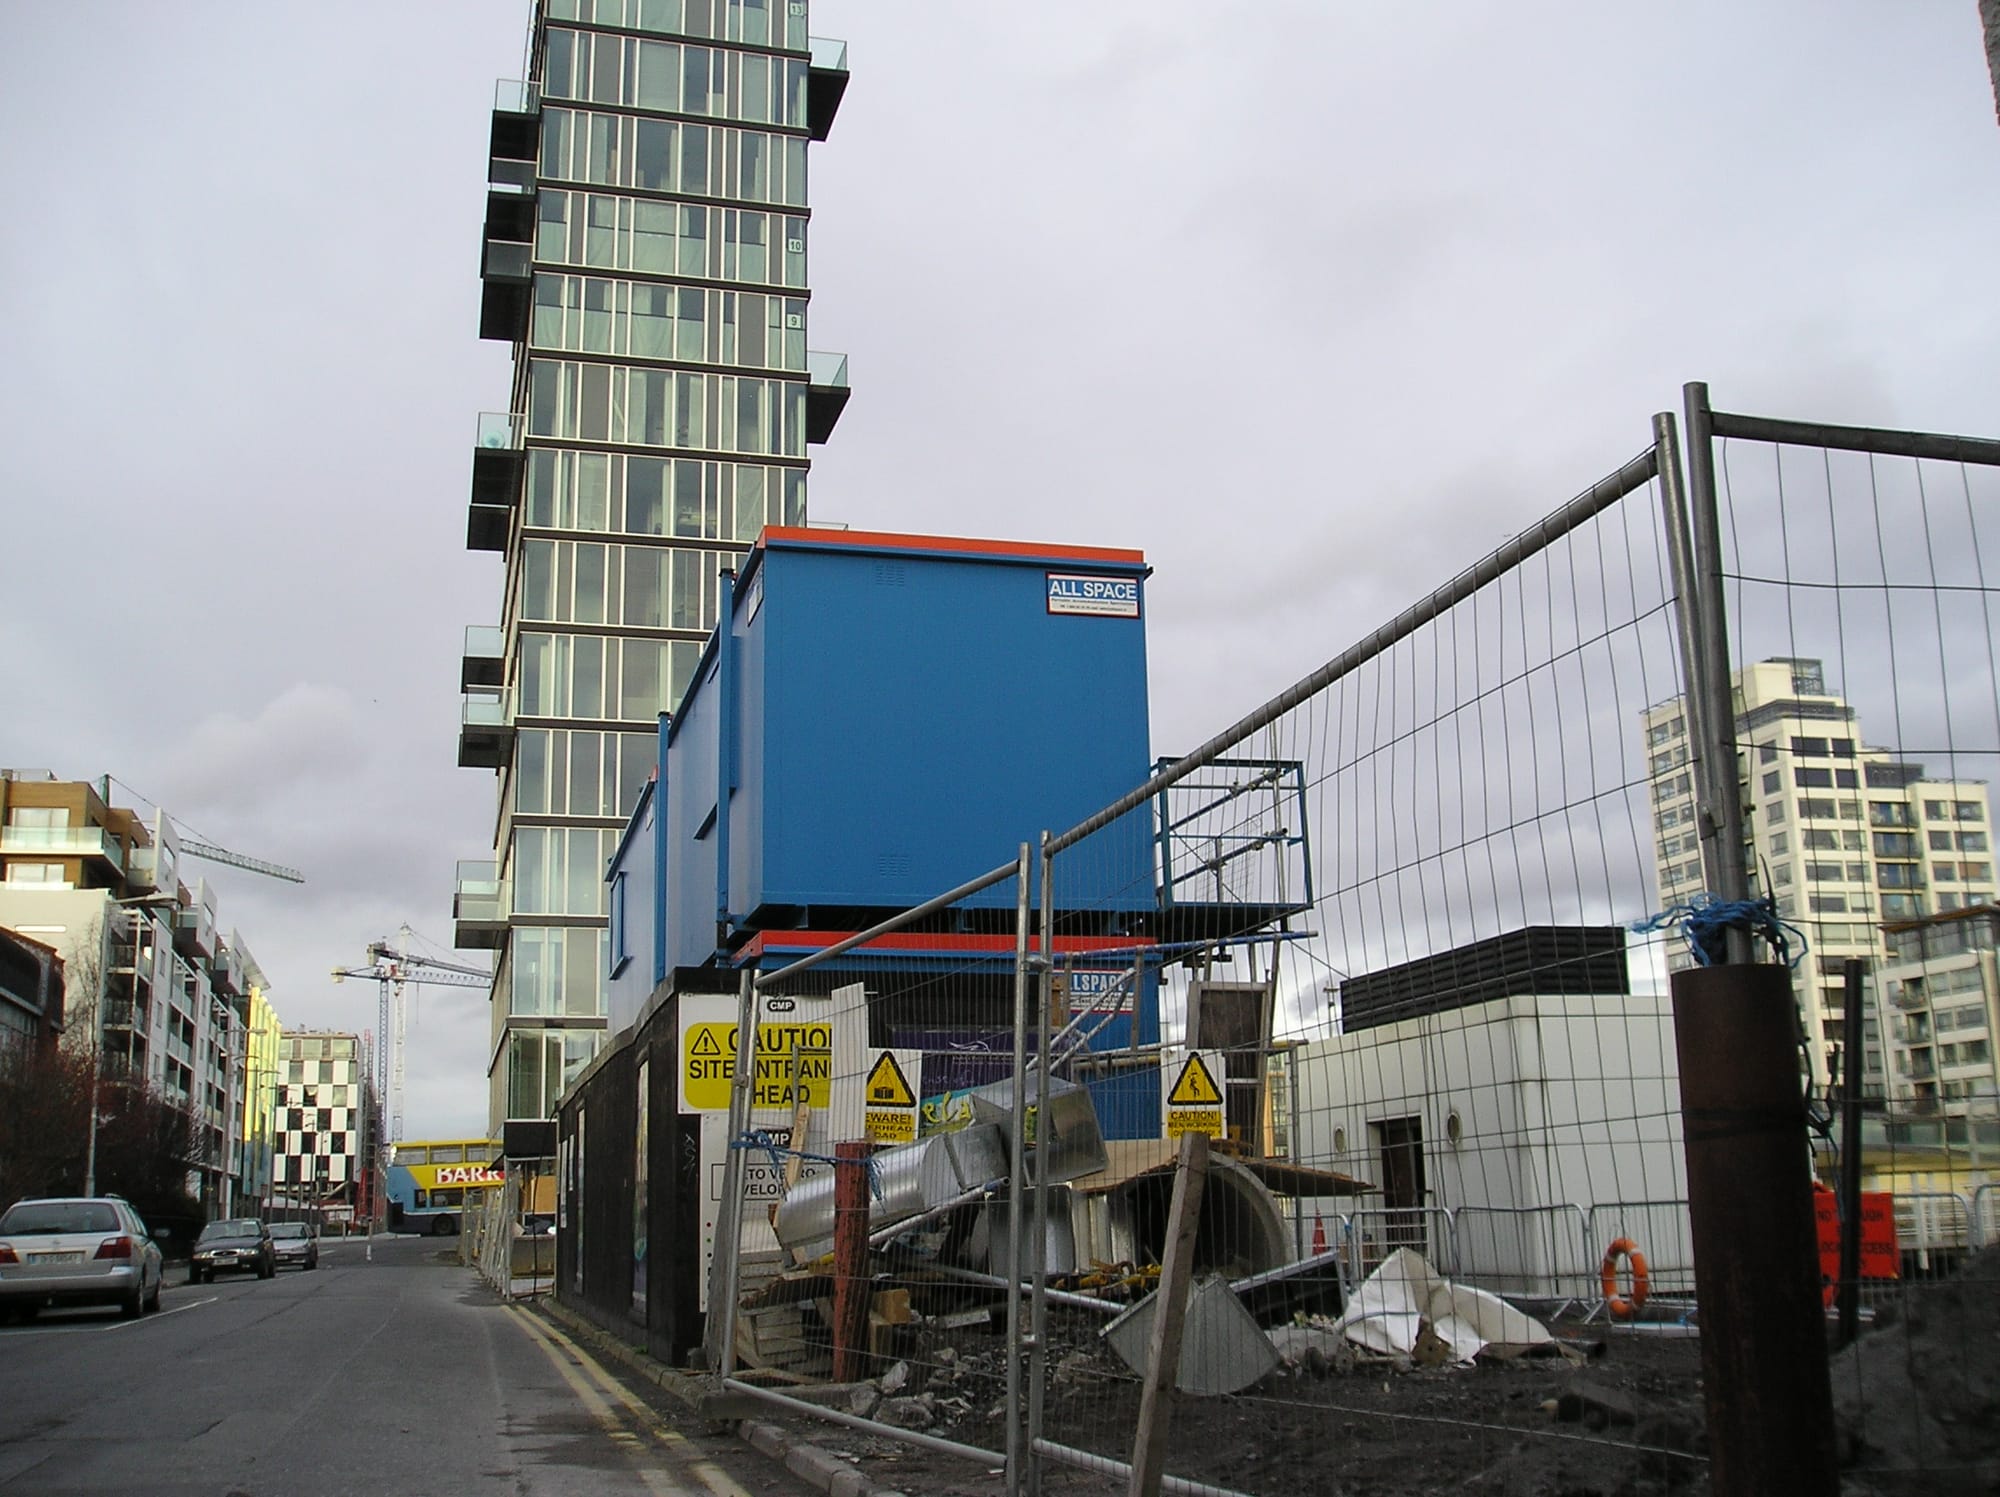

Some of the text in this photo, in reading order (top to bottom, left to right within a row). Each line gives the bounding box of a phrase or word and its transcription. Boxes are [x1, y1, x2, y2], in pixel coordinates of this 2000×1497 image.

[791, 241, 801, 251] 10
[791, 316, 798, 326] 9
[1049, 580, 1137, 600] ALL SPACE
[770, 1001, 793, 1010] CMP
[728, 1028, 832, 1052] CAUTIO
[689, 1060, 736, 1079] SITE
[753, 1085, 811, 1104] HEAD
[866, 1112, 912, 1124] EWARE!
[1171, 1111, 1217, 1121] CAUTION!
[874, 1131, 897, 1139] OAD
